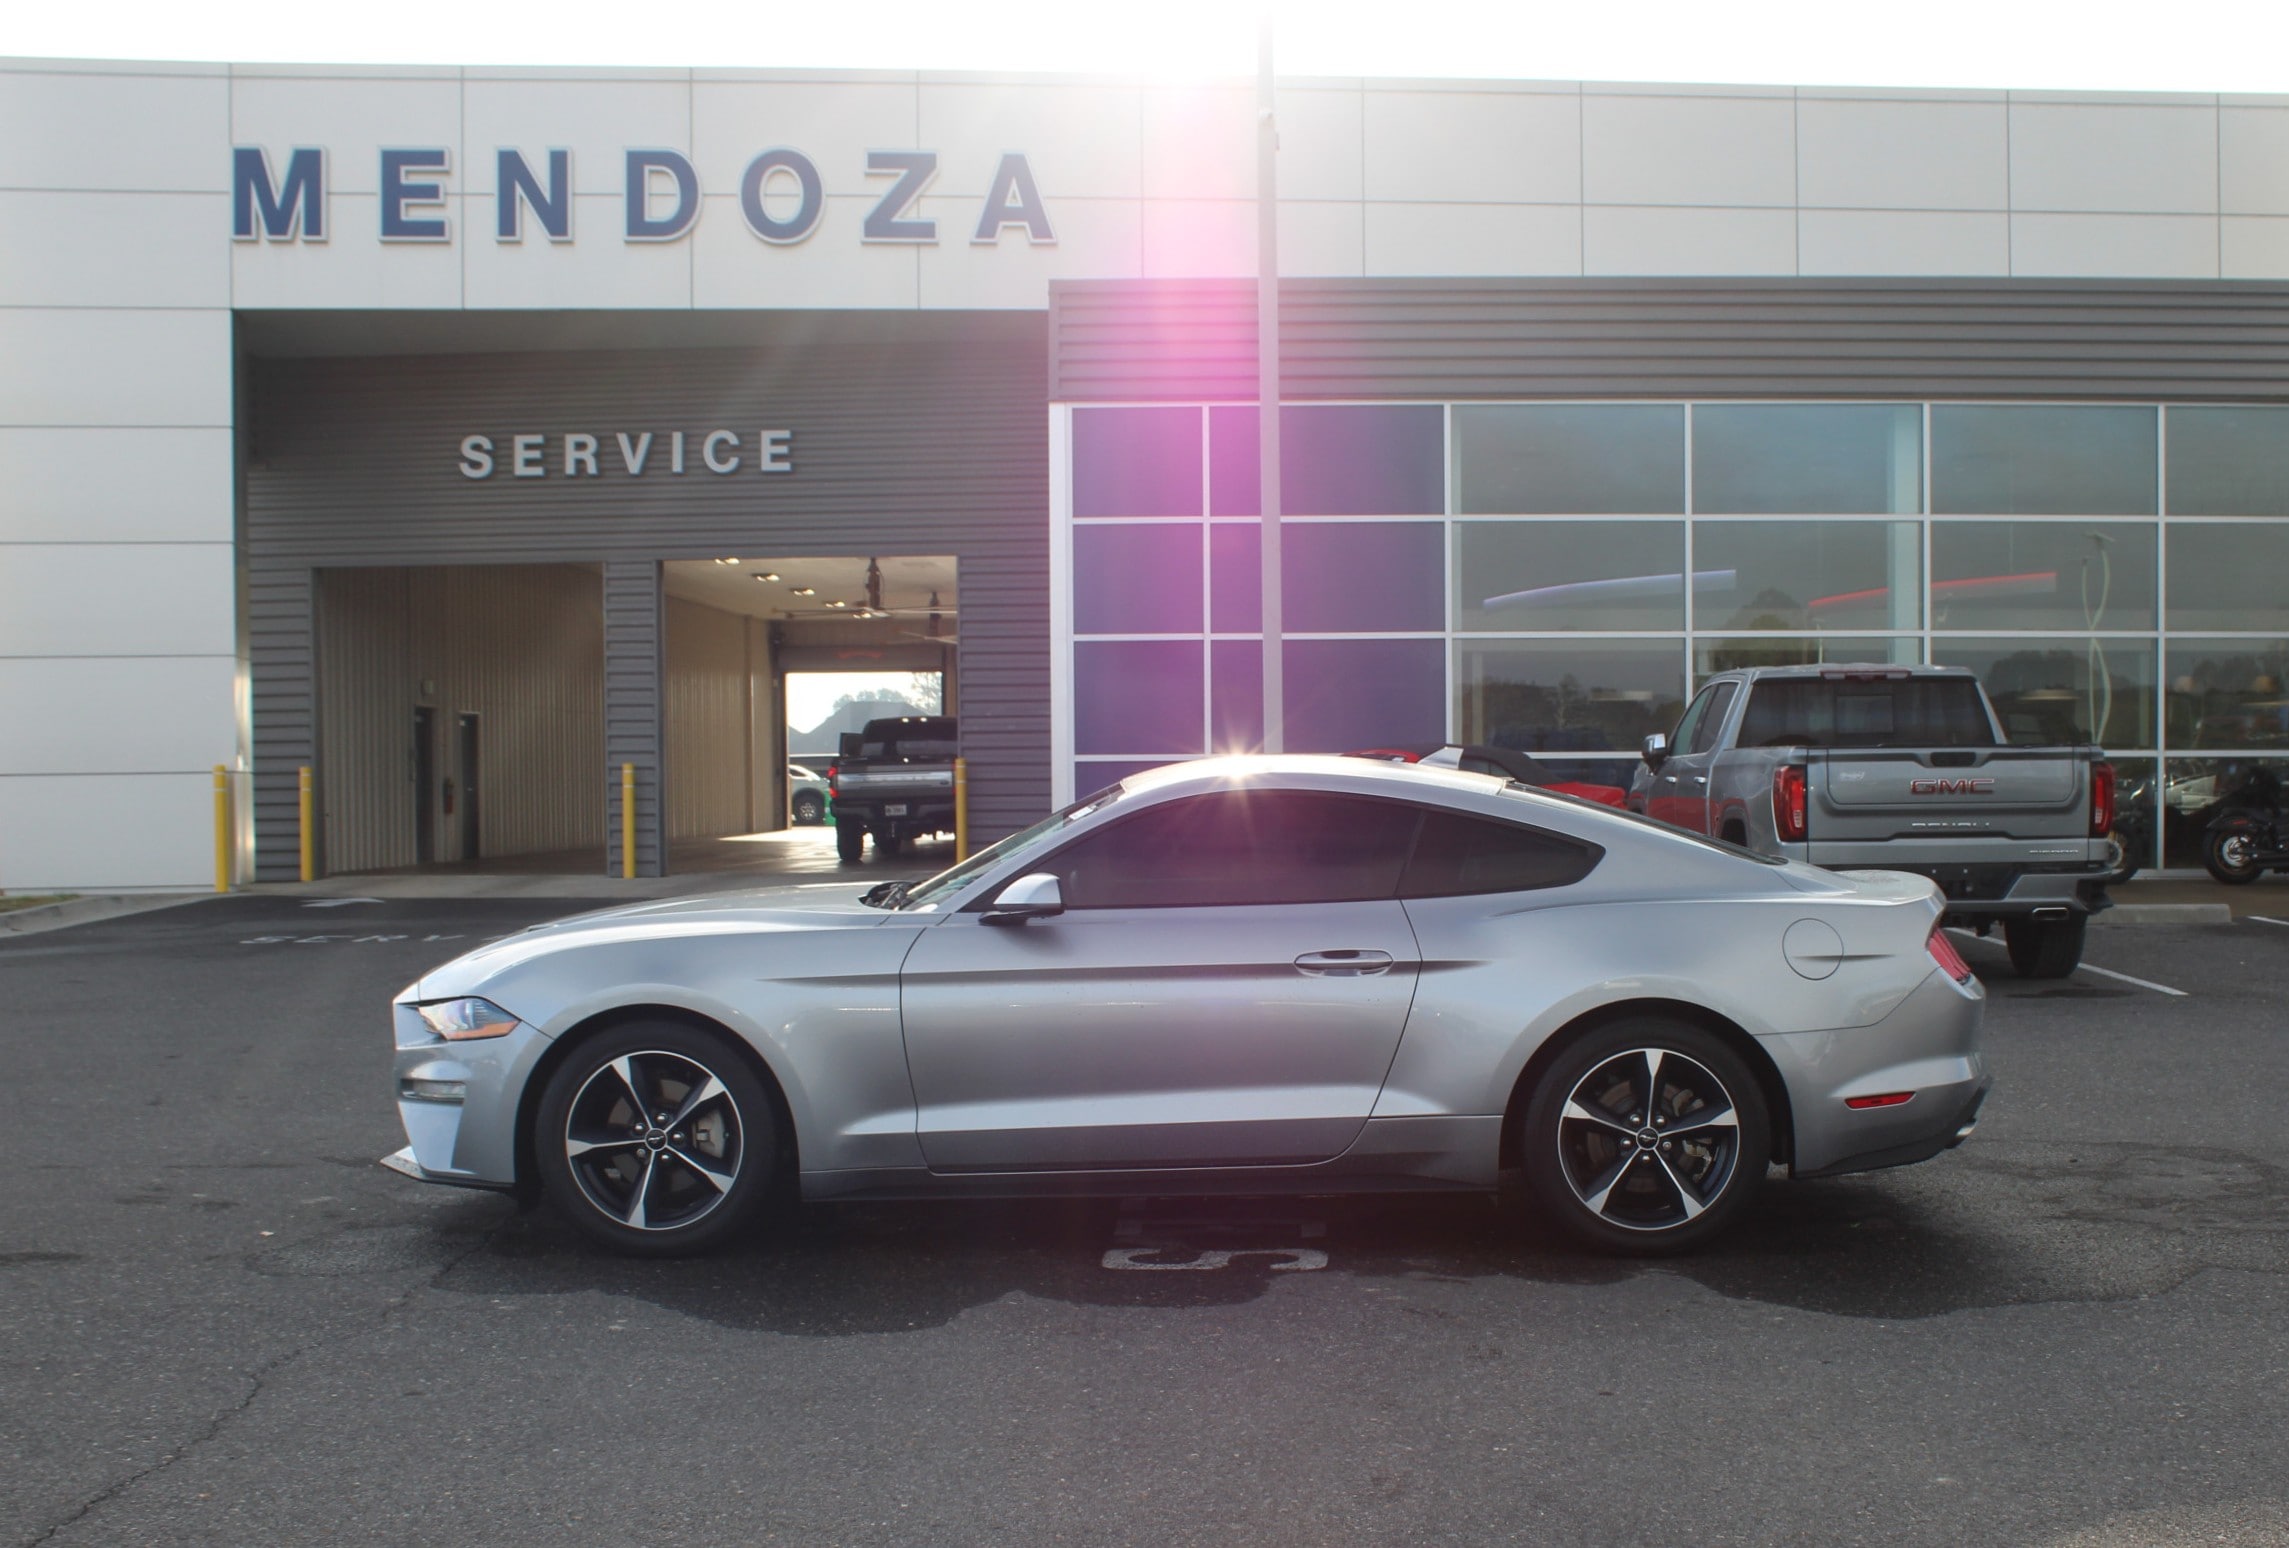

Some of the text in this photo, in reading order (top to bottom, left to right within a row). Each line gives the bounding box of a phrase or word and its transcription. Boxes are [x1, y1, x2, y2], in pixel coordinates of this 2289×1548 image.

[232, 145, 1058, 245] MENDOZA
[459, 428, 797, 480] SERVICE
[1910, 778, 1995, 795] GMC
